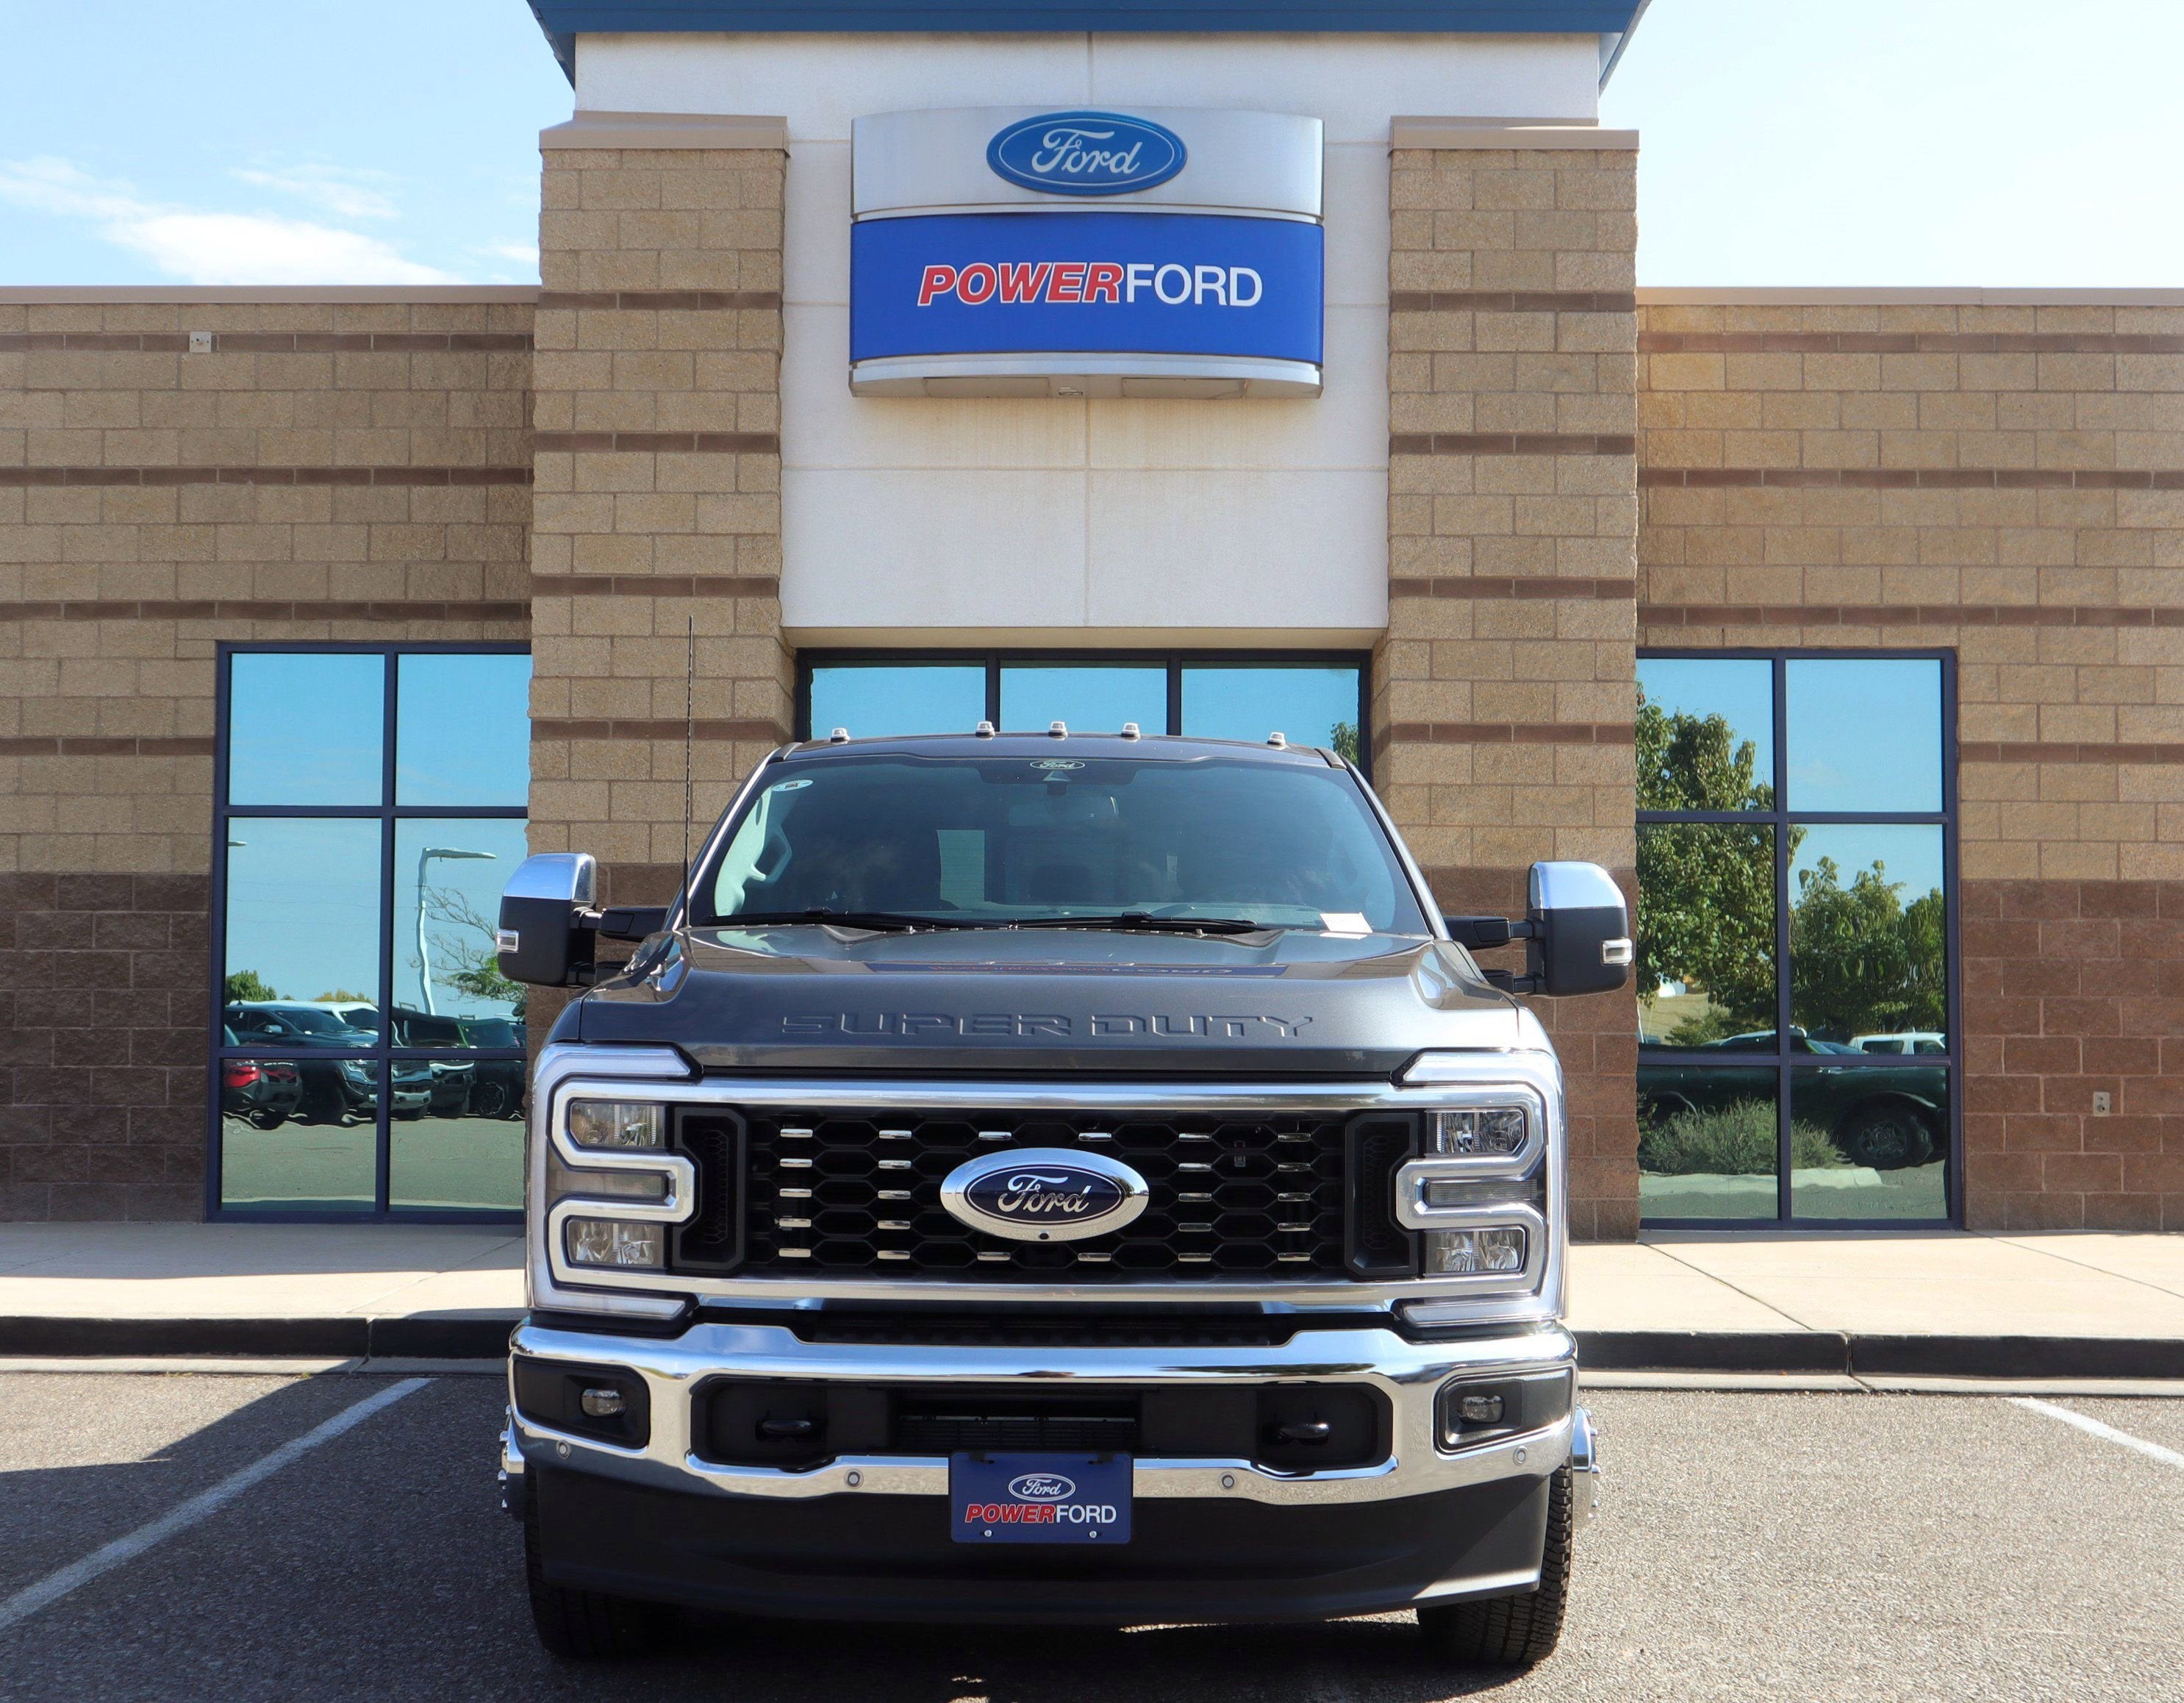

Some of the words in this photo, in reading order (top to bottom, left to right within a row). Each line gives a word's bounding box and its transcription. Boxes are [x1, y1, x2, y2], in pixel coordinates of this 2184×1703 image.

[1031, 128, 1143, 174] Ford
[917, 262, 1263, 307] POWERFORD
[1039, 760, 1075, 768] Ford
[782, 1013, 1072, 1036] SUPER
[1091, 1015, 1313, 1038] DUTY
[998, 1174, 1092, 1213] Ford
[1022, 1479, 1062, 1496] Ford
[964, 1504, 1117, 1524] POWERFORD
